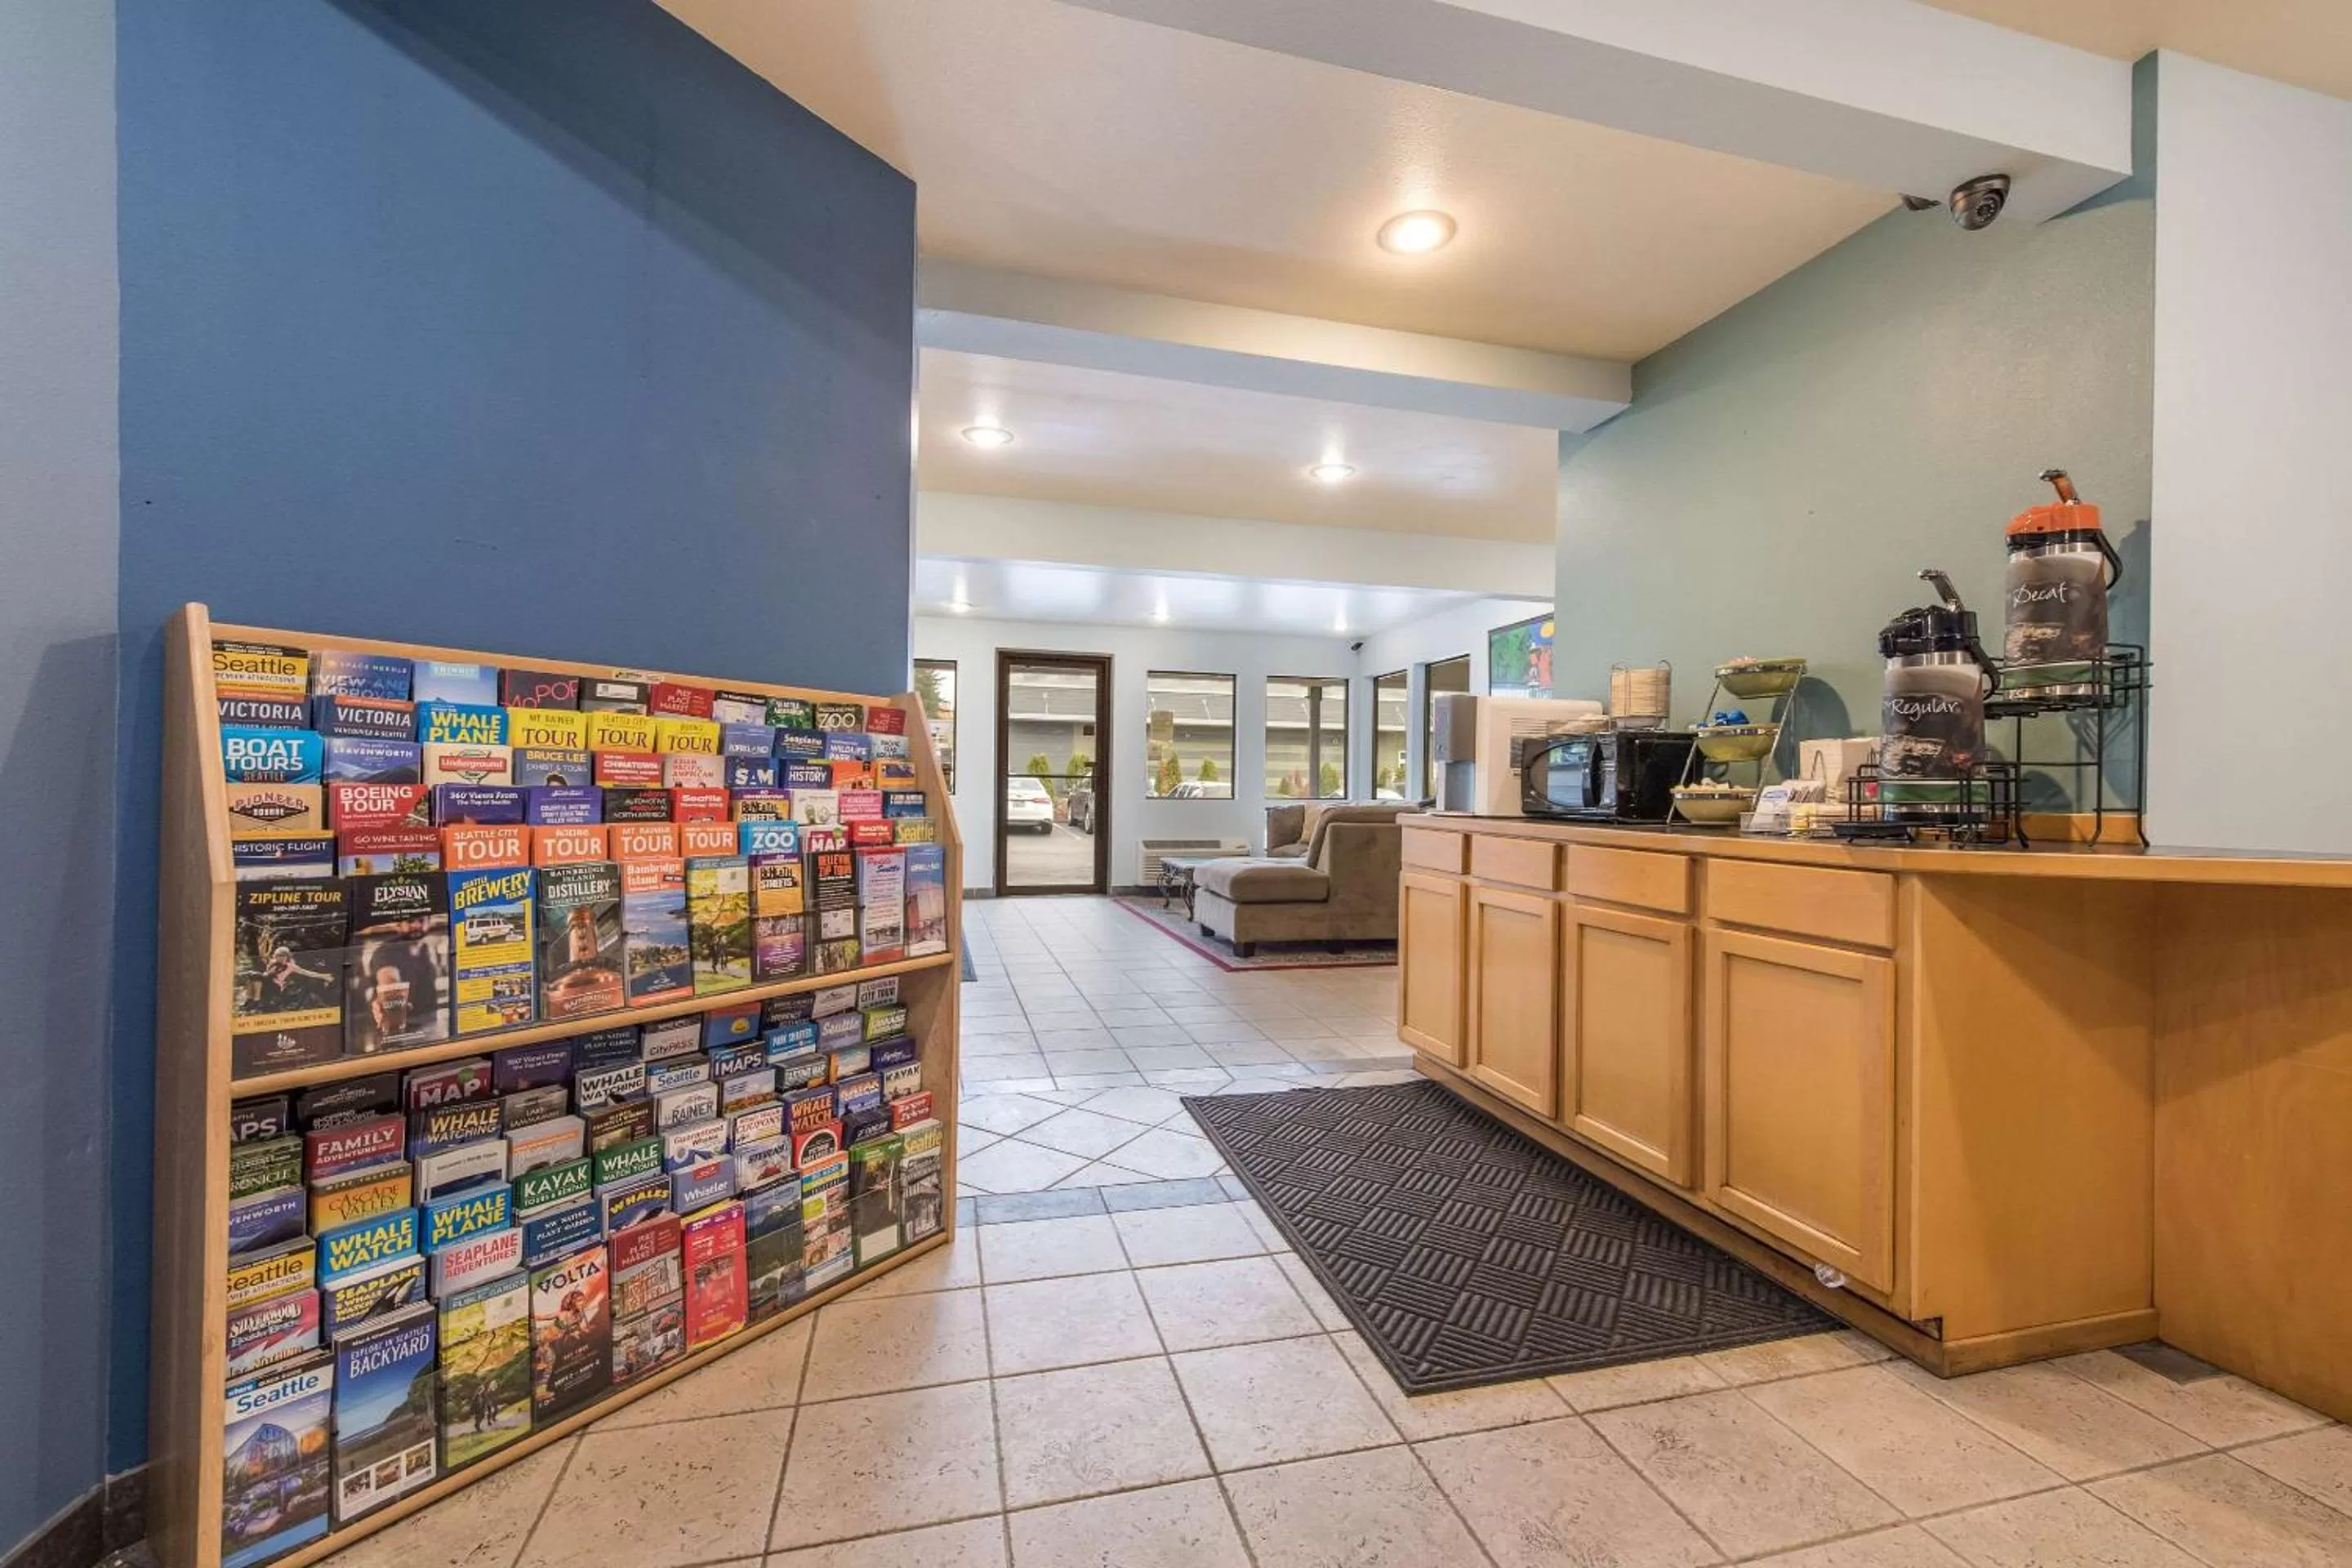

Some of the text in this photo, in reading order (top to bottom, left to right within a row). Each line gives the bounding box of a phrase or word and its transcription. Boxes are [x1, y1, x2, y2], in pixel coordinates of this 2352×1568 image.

[2013, 581, 2068, 608] Decaf
[212, 653, 296, 675] Seattle
[318, 675, 367, 688] VIEW
[218, 701, 302, 720] VICTORIA
[337, 707, 412, 727] VICTORIA
[1891, 699, 1958, 720] Regular
[431, 712, 501, 729] WHALE
[819, 713, 856, 728] ZOO
[430, 728, 500, 744] PLANE
[523, 728, 577, 748] TOUR
[598, 728, 648, 749] TOUR
[668, 735, 712, 752] TOUR
[227, 738, 305, 757] BOAT
[526, 751, 587, 763] BRUCE LEE
[225, 756, 304, 771] TOURS
[441, 759, 504, 773] Underground
[789, 770, 827, 782] HISTORY
[234, 792, 305, 811] PIONEER
[340, 786, 412, 800] BOEING
[341, 800, 395, 813] TOUR
[354, 834, 437, 844] GO WINE TASTING
[455, 831, 494, 840] SEATTLE
[685, 831, 733, 849] TOUR
[752, 832, 794, 849] ZOO
[898, 822, 934, 841] Seattle
[287, 842, 327, 851] FLIGHT
[454, 839, 521, 861] TOUR
[543, 838, 602, 856] TOUR
[621, 835, 674, 853] TOUR
[811, 836, 847, 851] MAP
[627, 863, 681, 878] Bainbridge
[455, 870, 532, 910] BREWERY
[548, 880, 611, 898] DISTILLERY
[627, 875, 658, 886] Island
[249, 892, 341, 905] ZIPLINE TOUR
[375, 884, 428, 902] ELYSIAN
[583, 1067, 643, 1092] WHALE
[658, 1069, 701, 1087] Seattle
[885, 1064, 920, 1080] KAYAK
[420, 1078, 481, 1107] MAP
[583, 1078, 642, 1102] WATCHING
[791, 1094, 832, 1117] WHALE
[430, 1107, 501, 1133] WHALE
[427, 1122, 497, 1143] WATCHING
[318, 1129, 396, 1156] FAMILY
[316, 1147, 377, 1165] ADVENTURE
[602, 1144, 659, 1172] WHALE
[524, 1165, 587, 1198] KAYAK
[329, 1184, 399, 1211] CASCADE
[609, 1188, 669, 1214] WHALES
[684, 1181, 728, 1203] Whistler
[340, 1196, 396, 1221] VALLEY
[433, 1192, 506, 1227] WHALE
[431, 1206, 505, 1245] PLANE
[330, 1218, 412, 1256] WHALE
[329, 1232, 412, 1272] WATCH
[445, 1232, 519, 1269] SEAPLANE
[444, 1247, 518, 1281] ADVENTURES
[335, 1267, 421, 1301] SEAPLANE
[538, 1261, 601, 1294] VOLTA
[350, 1333, 430, 1379] BACKYARD
[237, 1374, 319, 1414] Seattle
